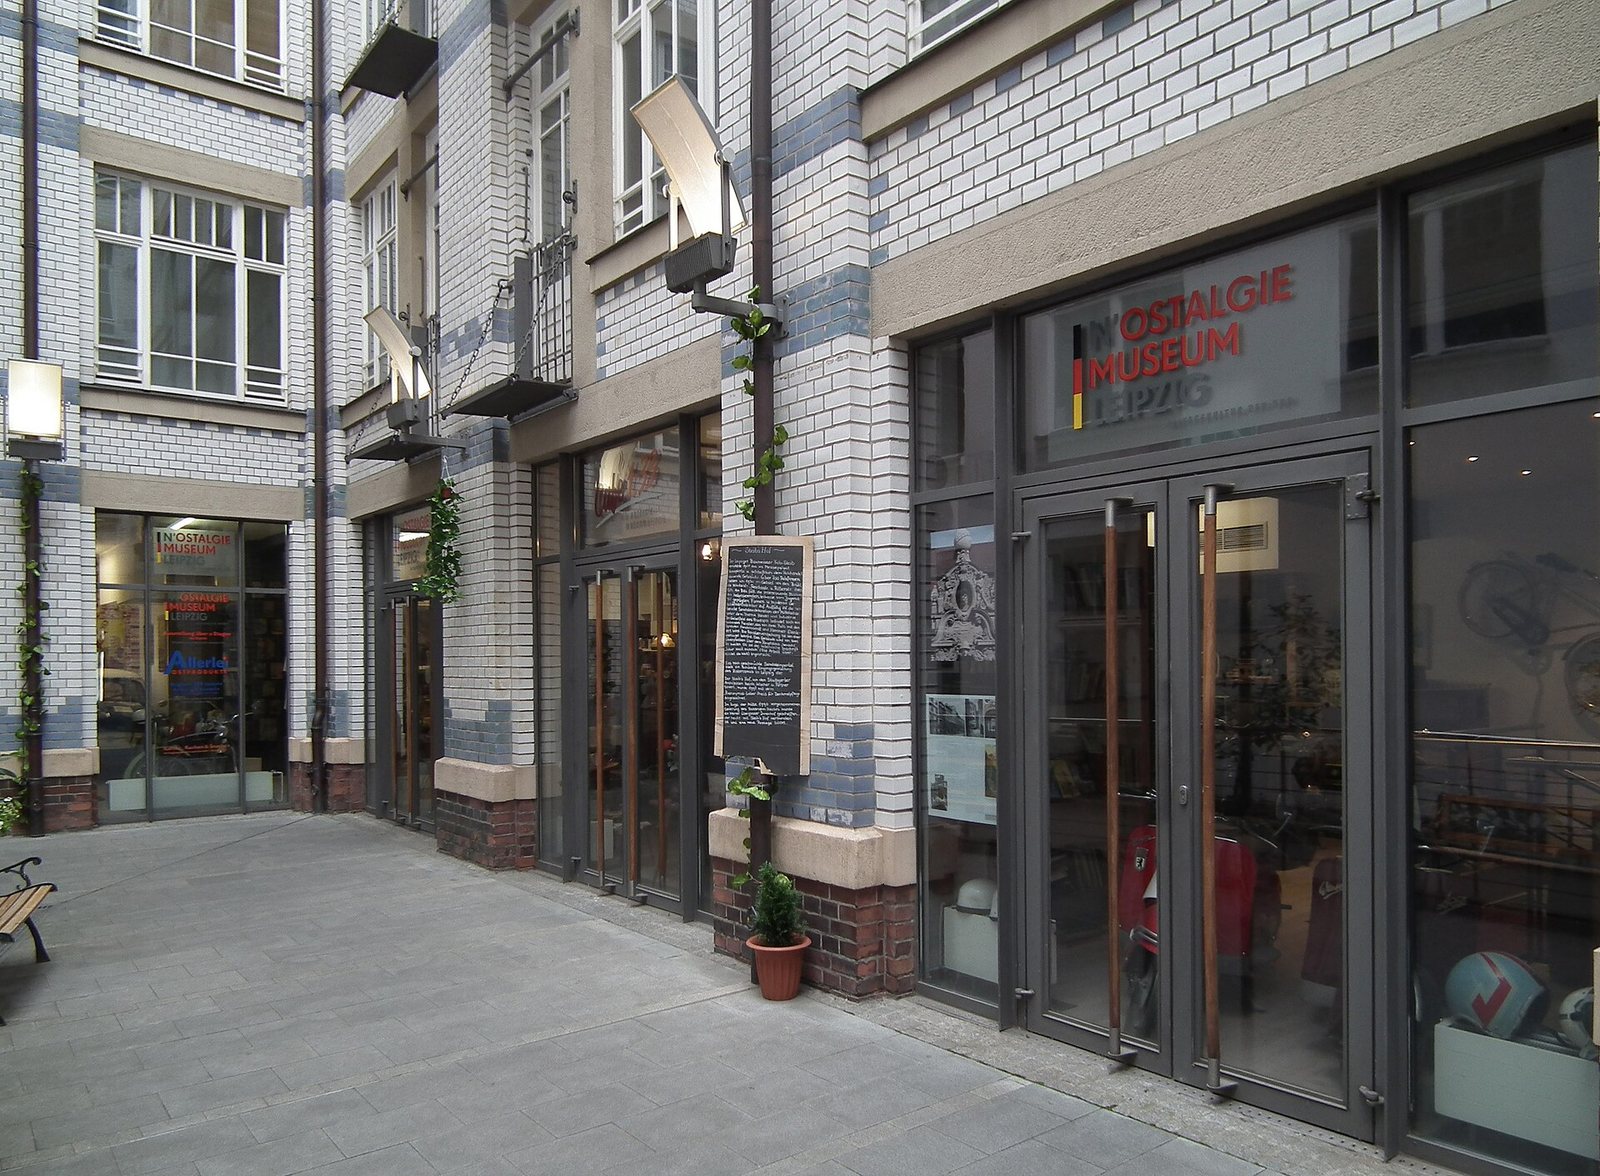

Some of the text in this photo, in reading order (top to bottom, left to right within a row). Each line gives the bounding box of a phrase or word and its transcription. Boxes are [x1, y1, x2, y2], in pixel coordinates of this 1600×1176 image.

[1087, 321, 1241, 390] MUSEUM
[1095, 372, 1213, 427] LEIPZIG
[162, 531, 231, 545] N'OSTALGIE
[162, 543, 217, 555] MUSEUM
[162, 554, 207, 567] LEIPZIG
[169, 603, 217, 613] MUSEUM
[170, 612, 209, 622] LEIPZIG
[163, 650, 230, 676] Allerlei
